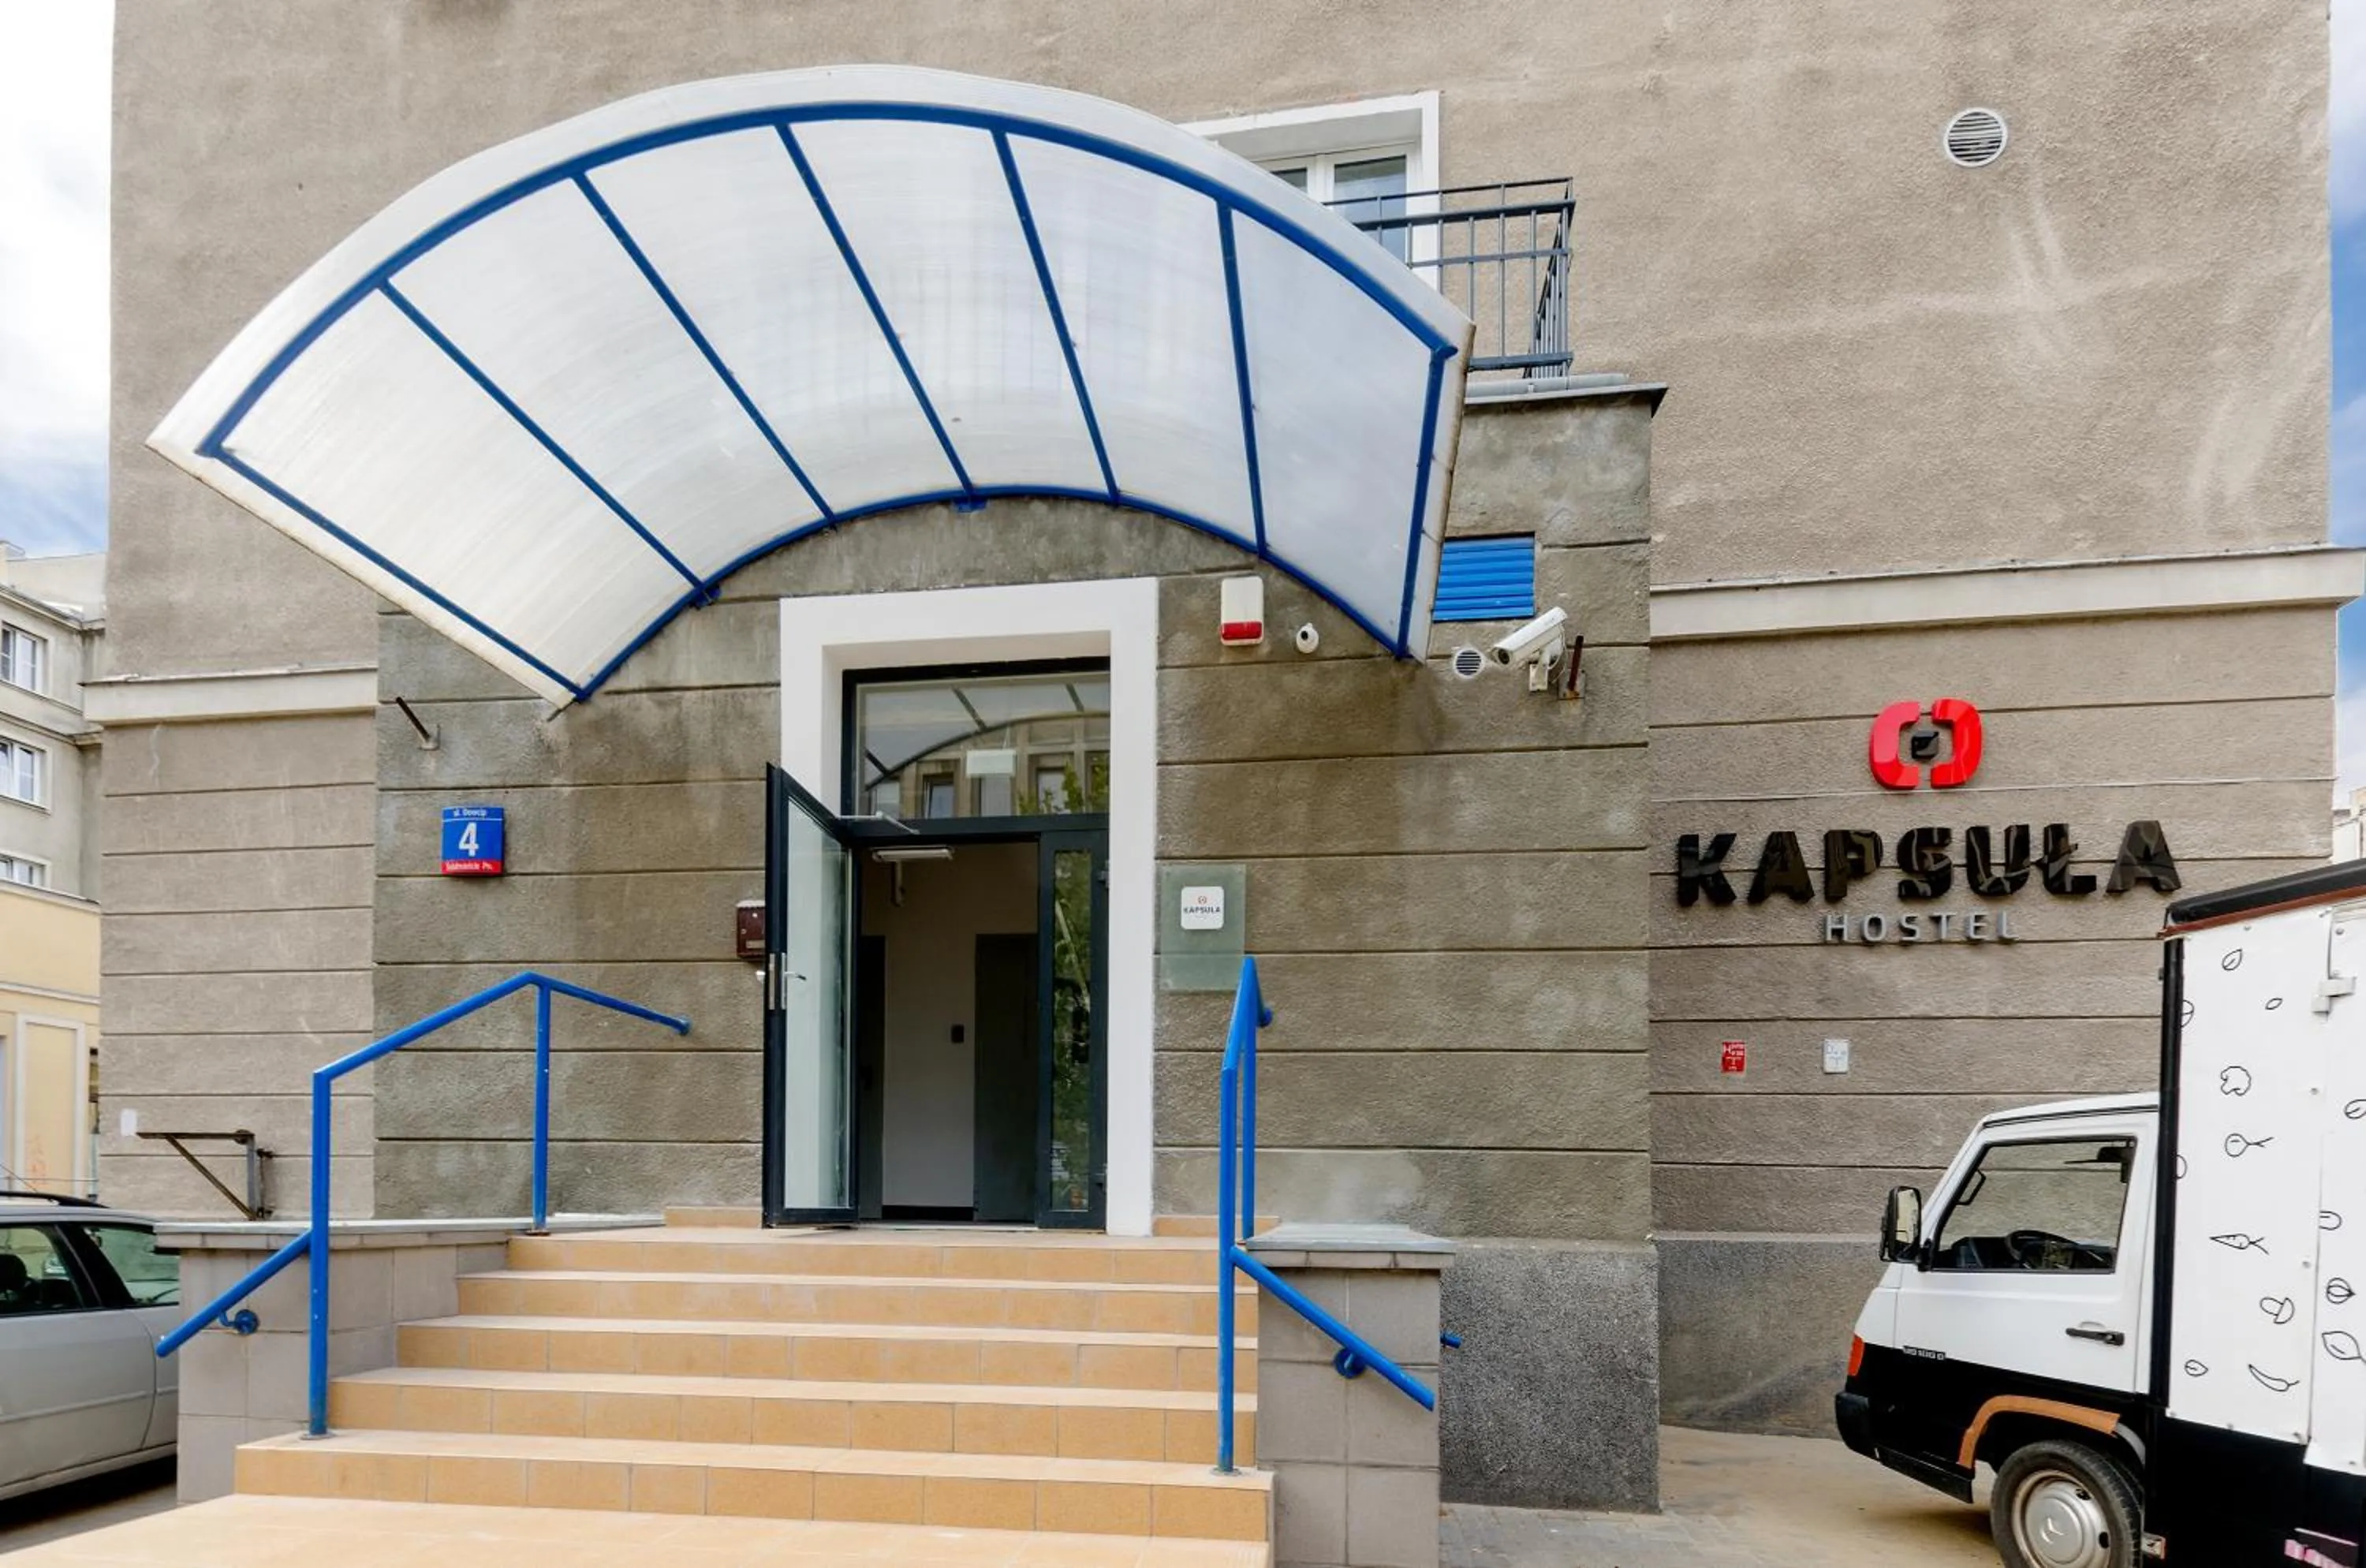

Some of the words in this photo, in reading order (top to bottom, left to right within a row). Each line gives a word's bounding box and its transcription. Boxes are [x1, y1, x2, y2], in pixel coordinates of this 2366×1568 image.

[458, 822, 480, 857] 4
[1677, 820, 2182, 906] KAPSUŁA
[1823, 909, 2018, 943] HOSTEL
